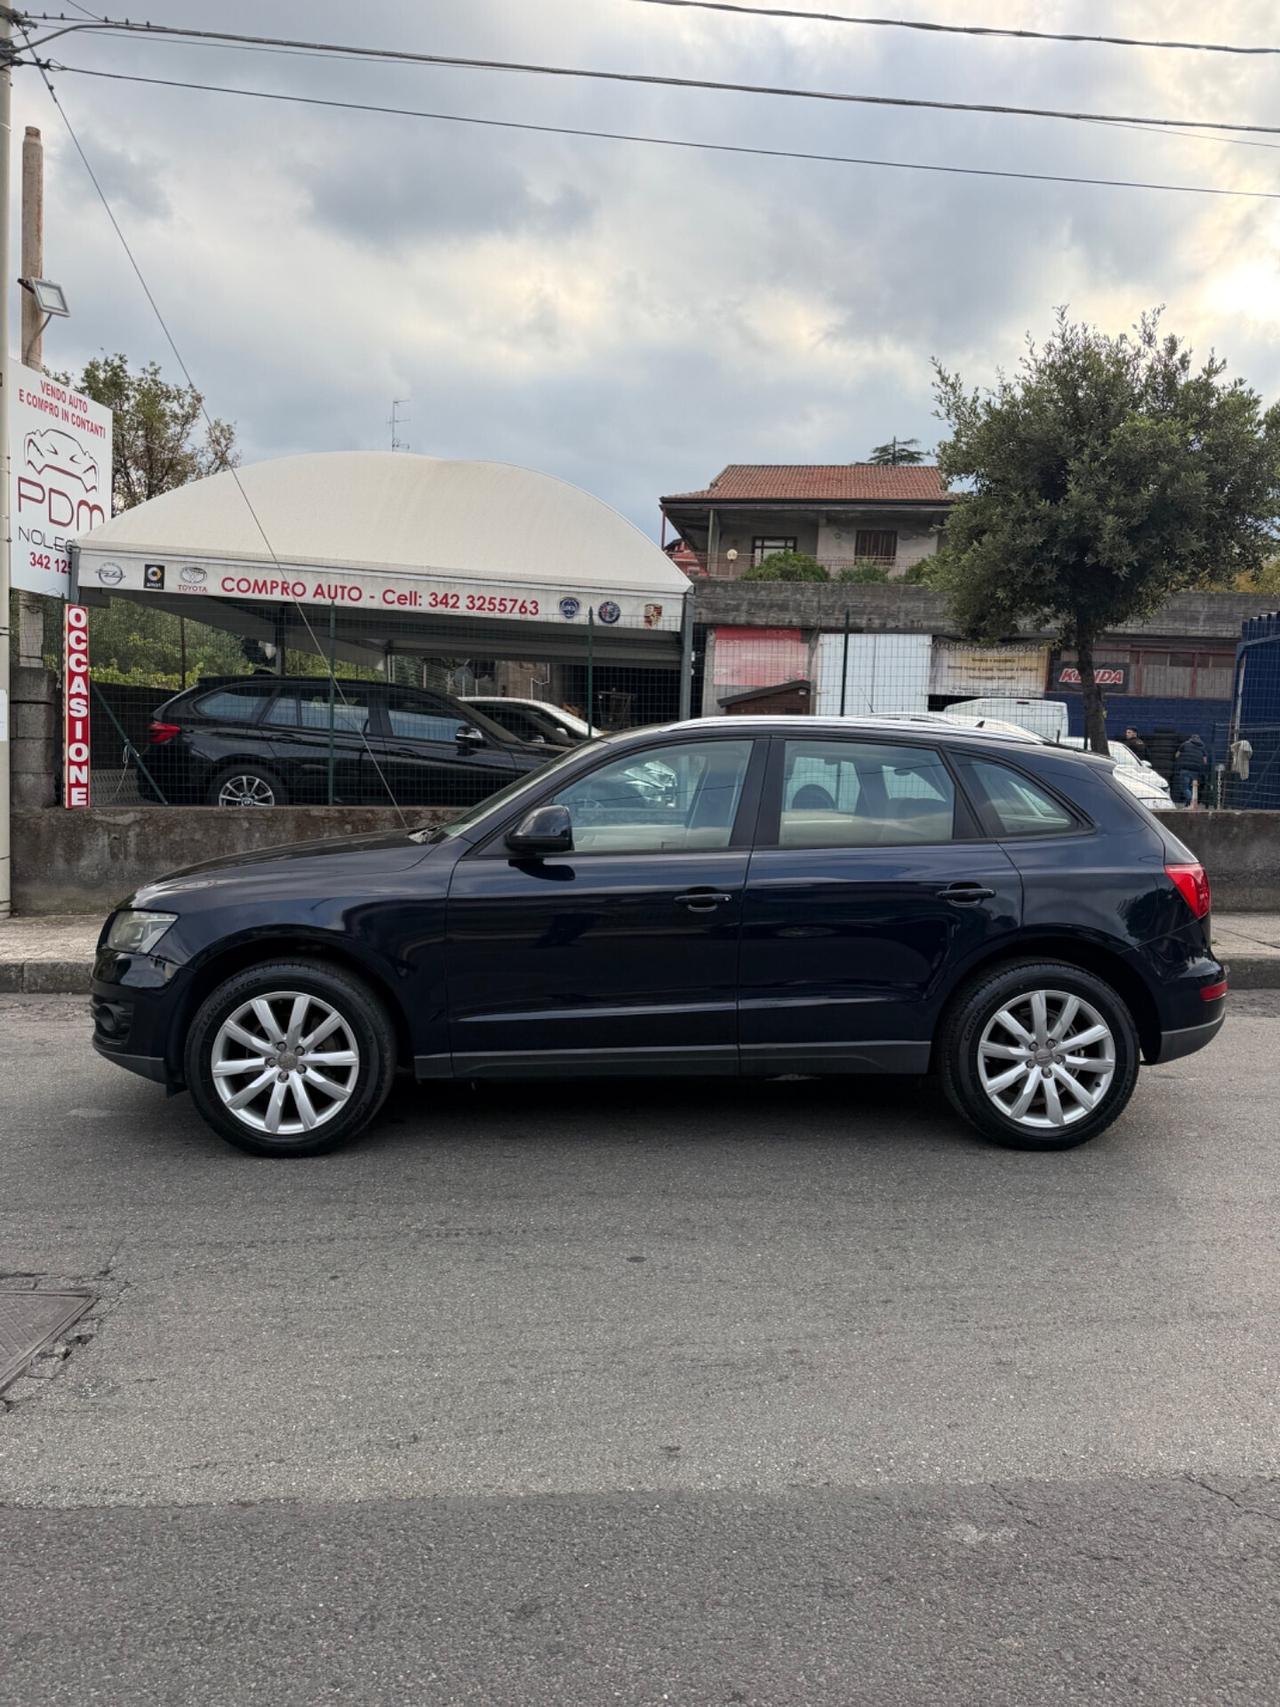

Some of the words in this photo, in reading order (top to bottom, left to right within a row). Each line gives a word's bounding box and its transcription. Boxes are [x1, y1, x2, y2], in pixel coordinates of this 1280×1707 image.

[40, 380, 66, 408] VENDO
[69, 394, 88, 413] AUTO
[19, 388, 24, 403] E
[26, 392, 60, 419] COMPRO
[62, 408, 69, 423] IN
[71, 413, 106, 440] CONTANTI
[30, 551, 51, 570] 342
[177, 584, 207, 593] TOYOTA
[221, 577, 307, 597] COMPRO
[313, 583, 362, 601] AUTO
[382, 588, 422, 607] Cell:
[428, 592, 460, 610] 342
[465, 595, 540, 616] 3255763
[1058, 668, 1124, 684] KDA
[68, 608, 88, 806] OCCASIONE
